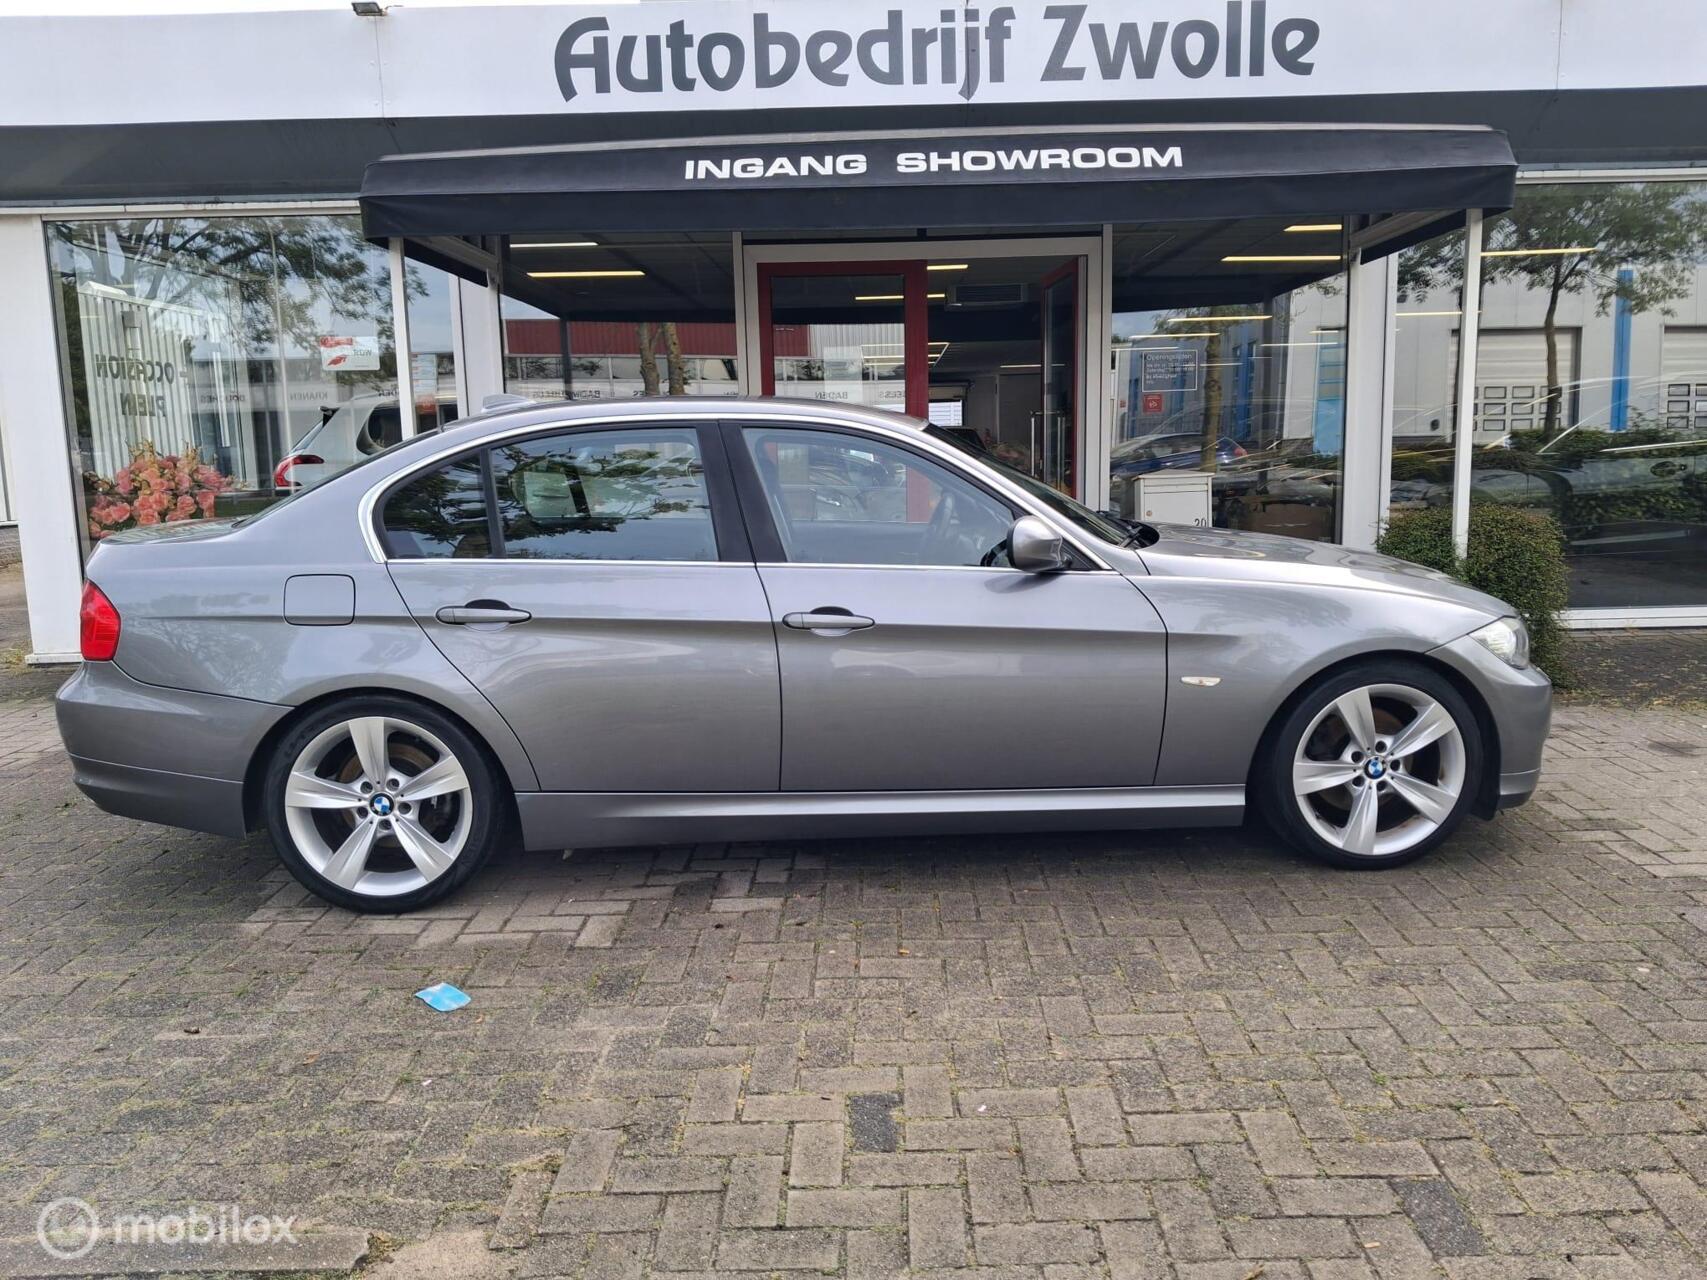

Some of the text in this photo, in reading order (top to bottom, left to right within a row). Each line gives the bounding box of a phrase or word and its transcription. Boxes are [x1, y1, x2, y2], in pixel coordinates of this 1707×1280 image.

[554, 0, 1321, 102] Autobedrijf Zwolle
[684, 146, 1184, 181] INGANG SHOWROOM
